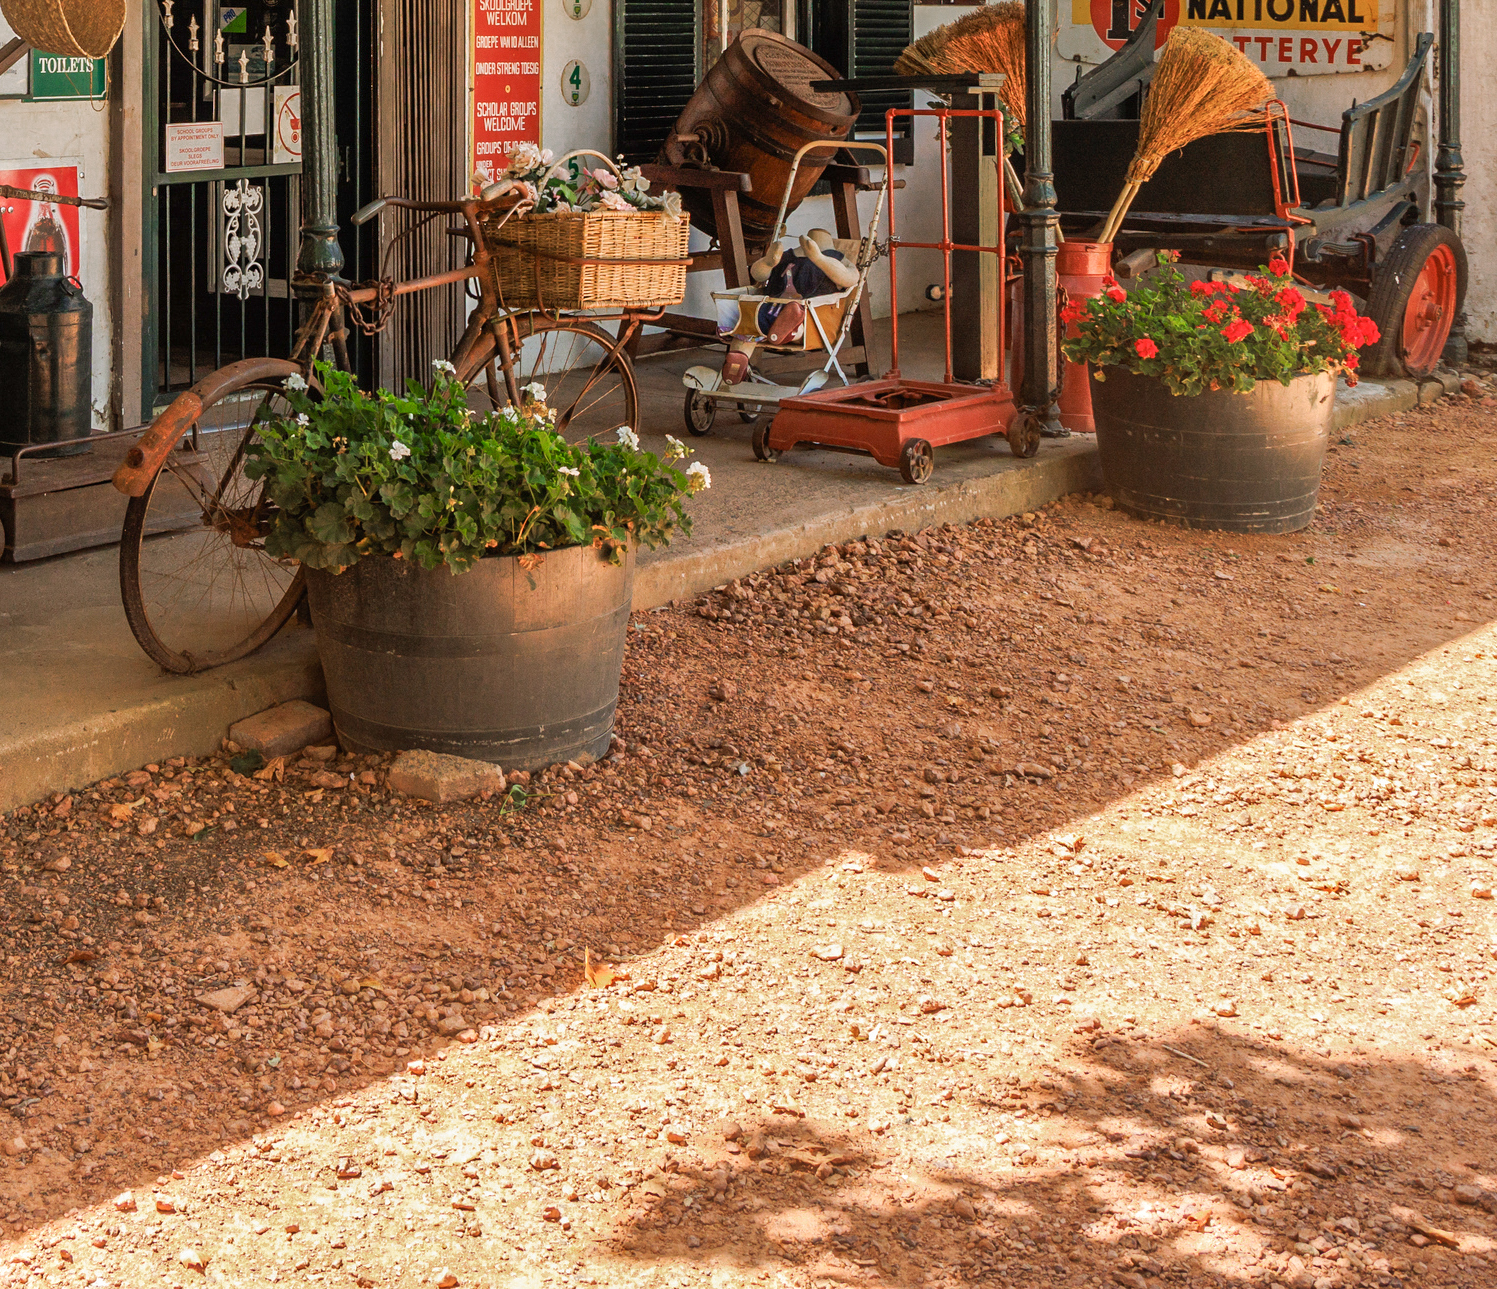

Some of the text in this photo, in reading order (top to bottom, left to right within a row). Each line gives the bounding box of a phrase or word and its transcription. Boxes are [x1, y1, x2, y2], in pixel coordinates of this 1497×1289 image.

[223, 8, 236, 24] PRO
[486, 11, 527, 26] WELKOM
[476, 35, 498, 48] GROEPE
[500, 36, 511, 48] VAN
[518, 36, 538, 48] ALLEEN
[1232, 35, 1362, 64] TTERYE
[39, 57, 94, 73] TOILETS
[476, 62, 539, 75] ONDER STRENG TOESIG
[569, 65, 581, 90] 4
[477, 102, 536, 117] SCHOLAR GROUPS
[484, 117, 525, 131] WELCOME
[477, 141, 502, 155] GROUPS
[568, 156, 579, 181] 5
